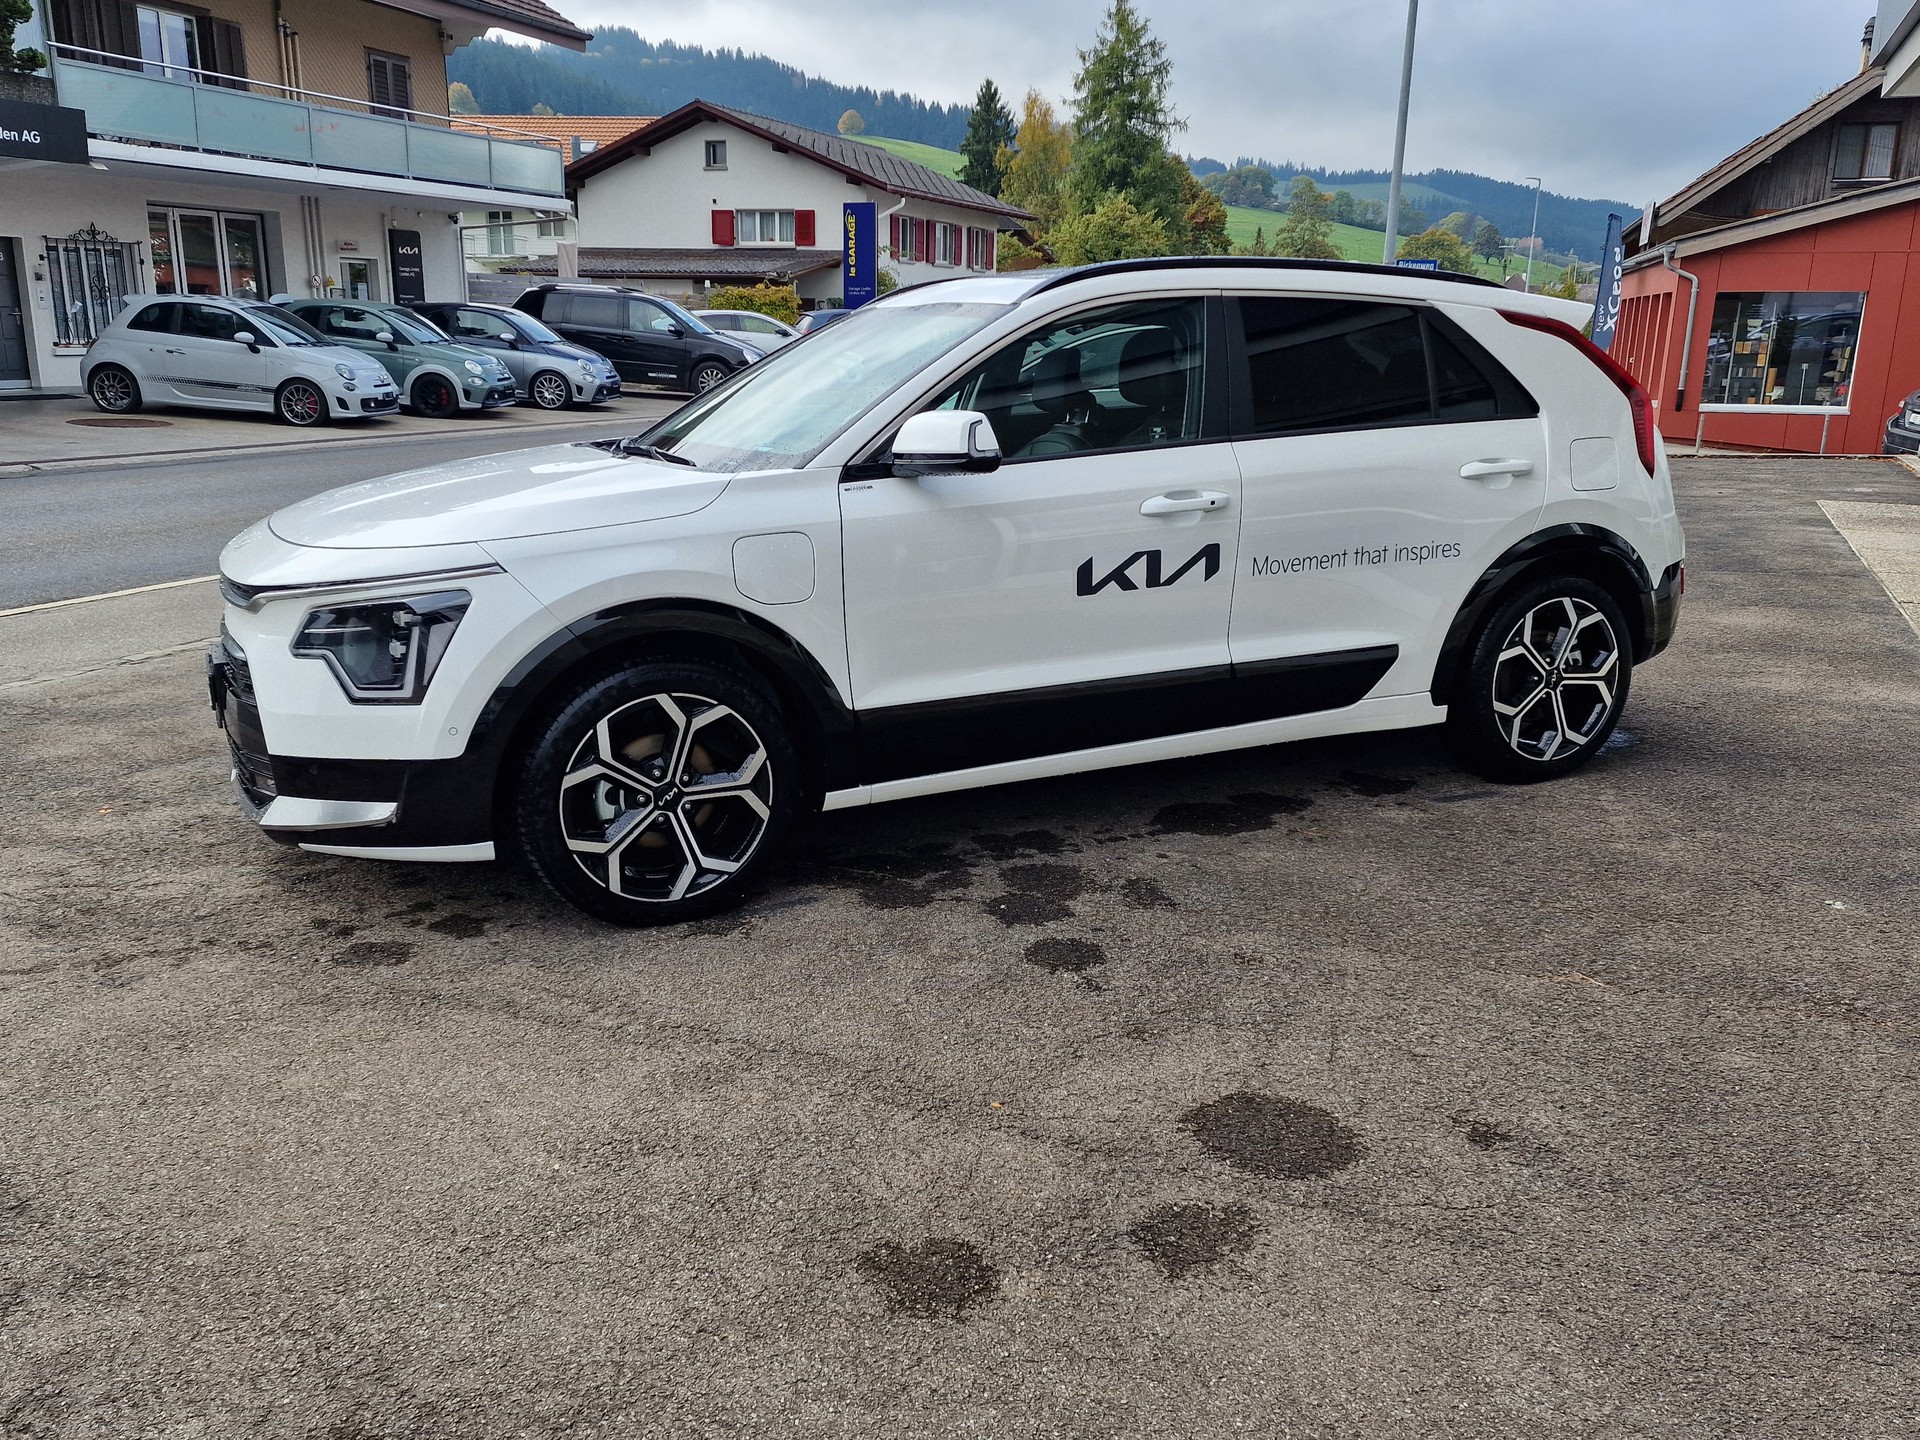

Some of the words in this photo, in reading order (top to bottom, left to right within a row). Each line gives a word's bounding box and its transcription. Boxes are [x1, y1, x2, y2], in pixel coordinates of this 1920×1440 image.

[21, 129, 41, 144] AG
[398, 245, 419, 255] KIA
[848, 267, 855, 276] le
[1595, 304, 1605, 332] New
[1252, 549, 1348, 577] Movement
[1354, 545, 1389, 566] that
[1394, 541, 1461, 565] inspires
[1076, 543, 1220, 597] KIA
